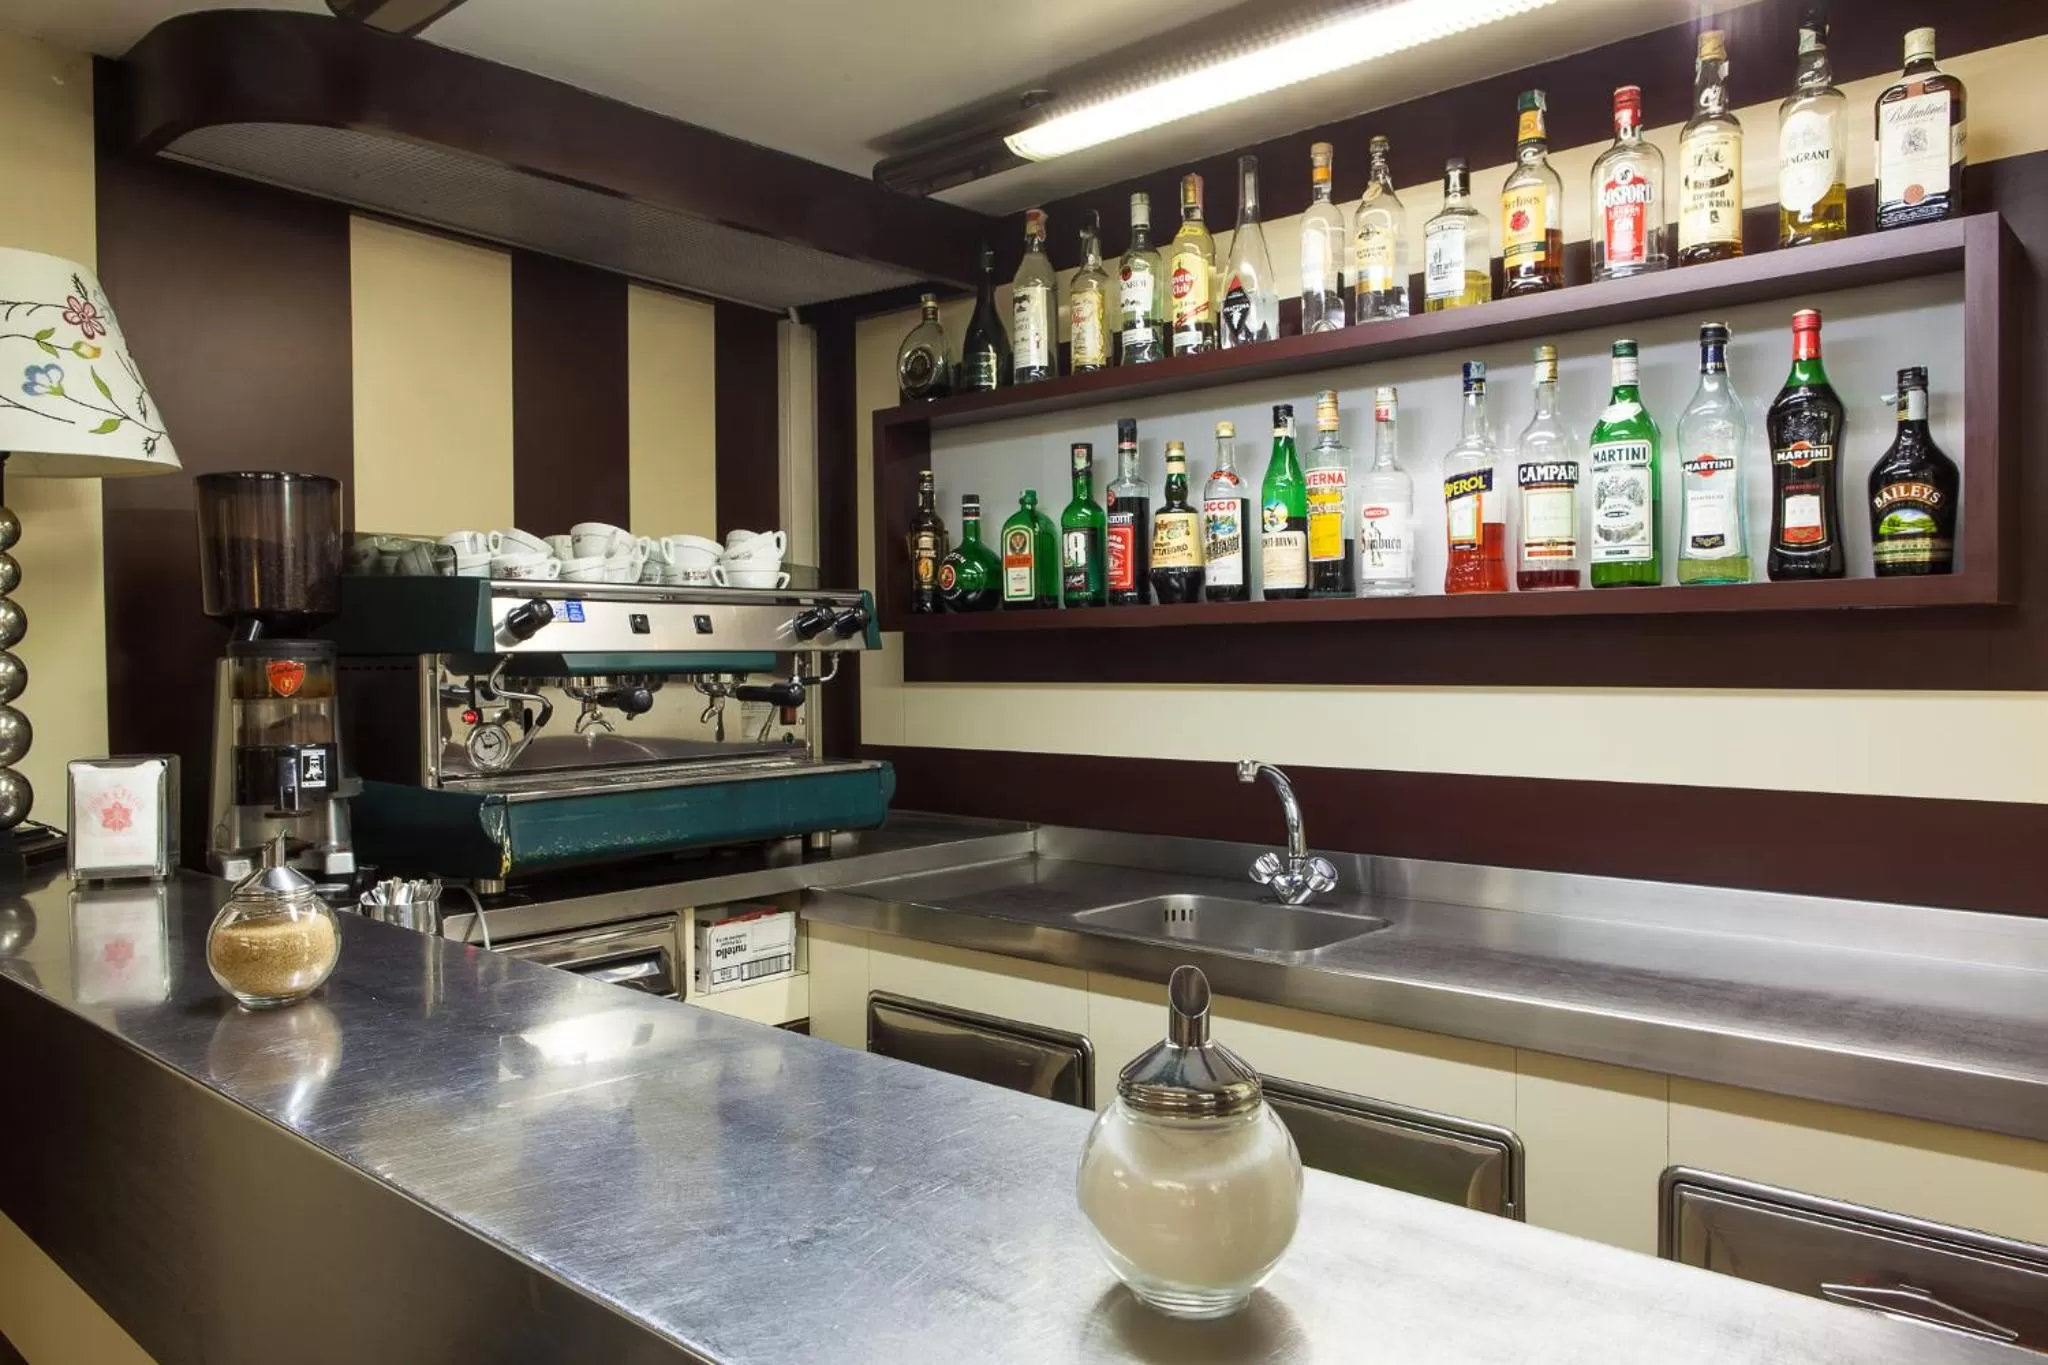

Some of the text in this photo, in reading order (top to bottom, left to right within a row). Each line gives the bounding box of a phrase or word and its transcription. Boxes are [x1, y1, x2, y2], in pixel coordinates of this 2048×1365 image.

[1593, 446, 1646, 464] MARTINI
[1777, 449, 1828, 463] MARTINI
[1519, 464, 1578, 483] CAMPARI
[1683, 460, 1733, 473] MARTINI
[1305, 472, 1345, 487] VERNA
[1874, 485, 1941, 508] BAILEYS
